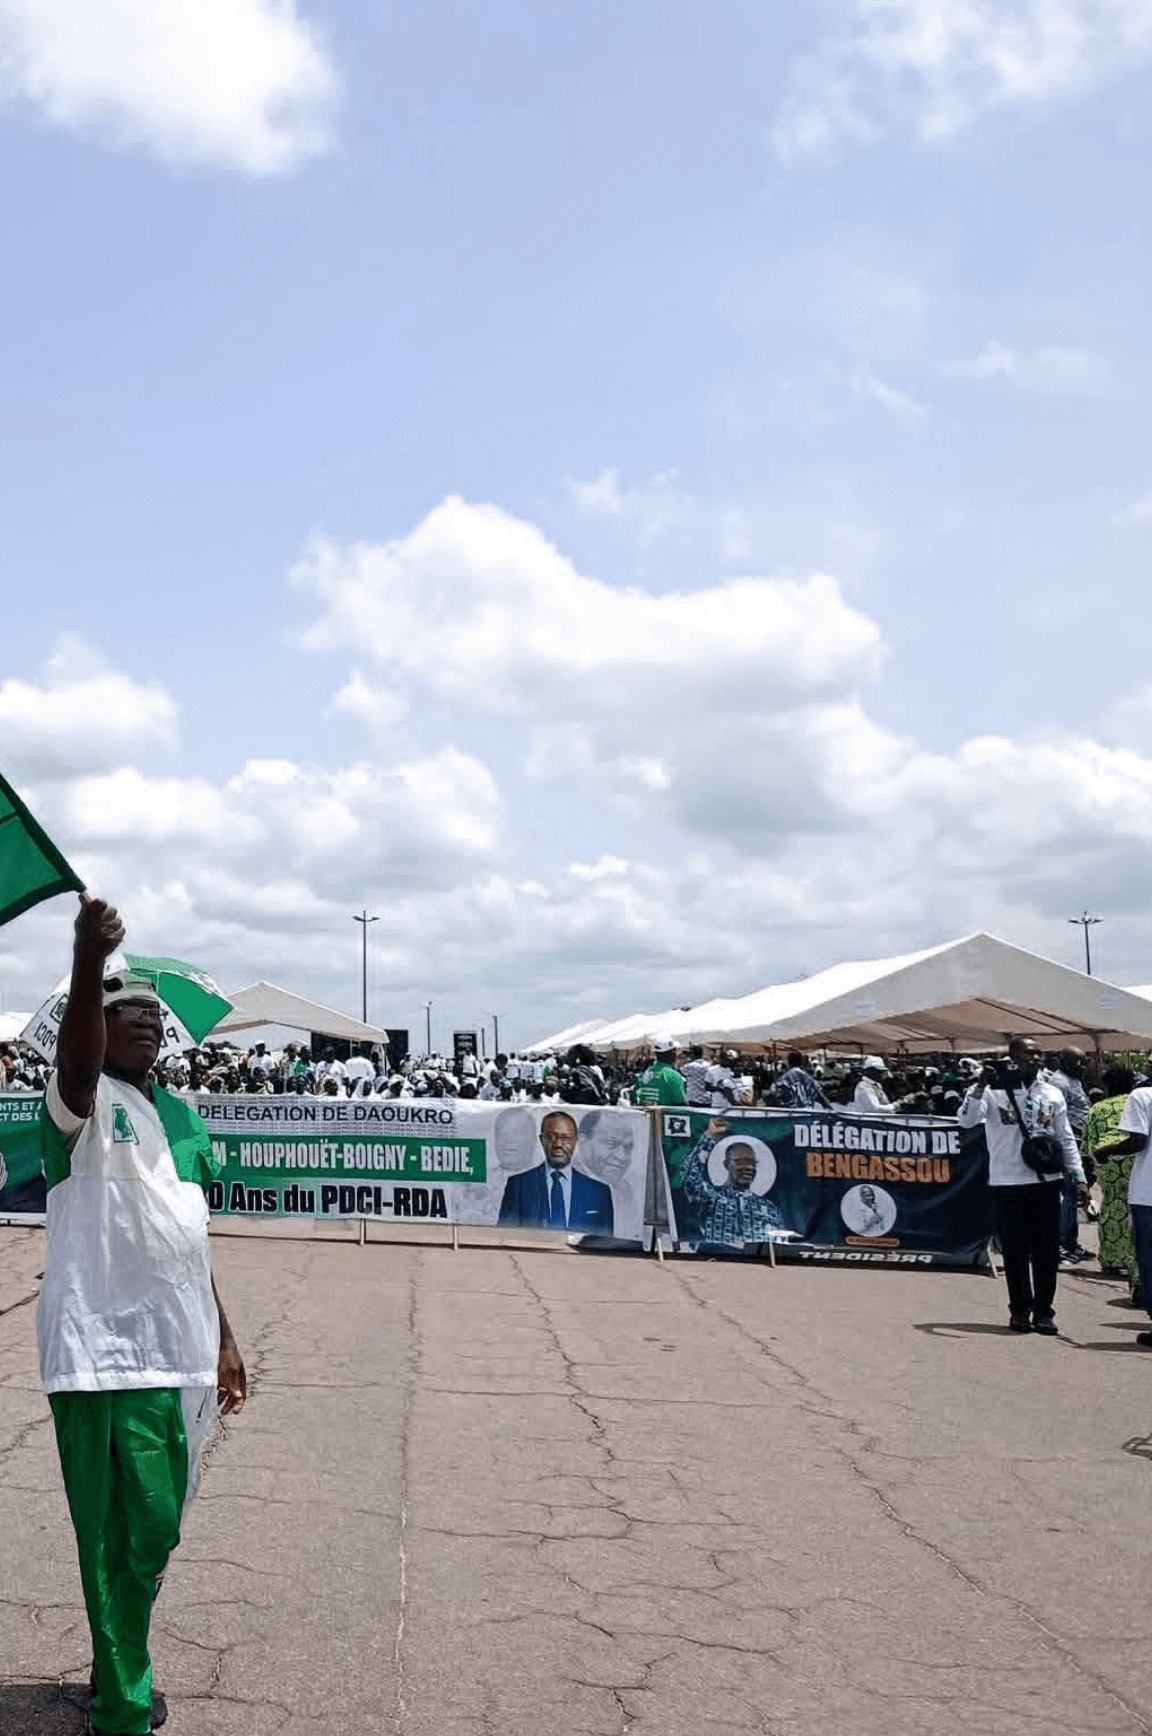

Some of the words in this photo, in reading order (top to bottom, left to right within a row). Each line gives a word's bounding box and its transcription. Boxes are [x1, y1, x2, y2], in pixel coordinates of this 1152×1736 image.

[11, 1112, 33, 1122] DES
[21, 1101, 35, 1111] ET
[199, 1104, 317, 1121] DELEGATION
[322, 1105, 351, 1121] DE
[353, 1105, 454, 1124] DAOUKRO
[794, 1121, 927, 1153] DÉLÉGATION
[932, 1130, 961, 1154] DE
[240, 1139, 406, 1172] HOUPHOUËT-BOIGNY
[421, 1144, 474, 1176] BEDIE,
[806, 1152, 951, 1183] BENGASSOU
[228, 1182, 280, 1214] Ans
[282, 1182, 316, 1215] du
[321, 1185, 448, 1219] PDCI-RDA
